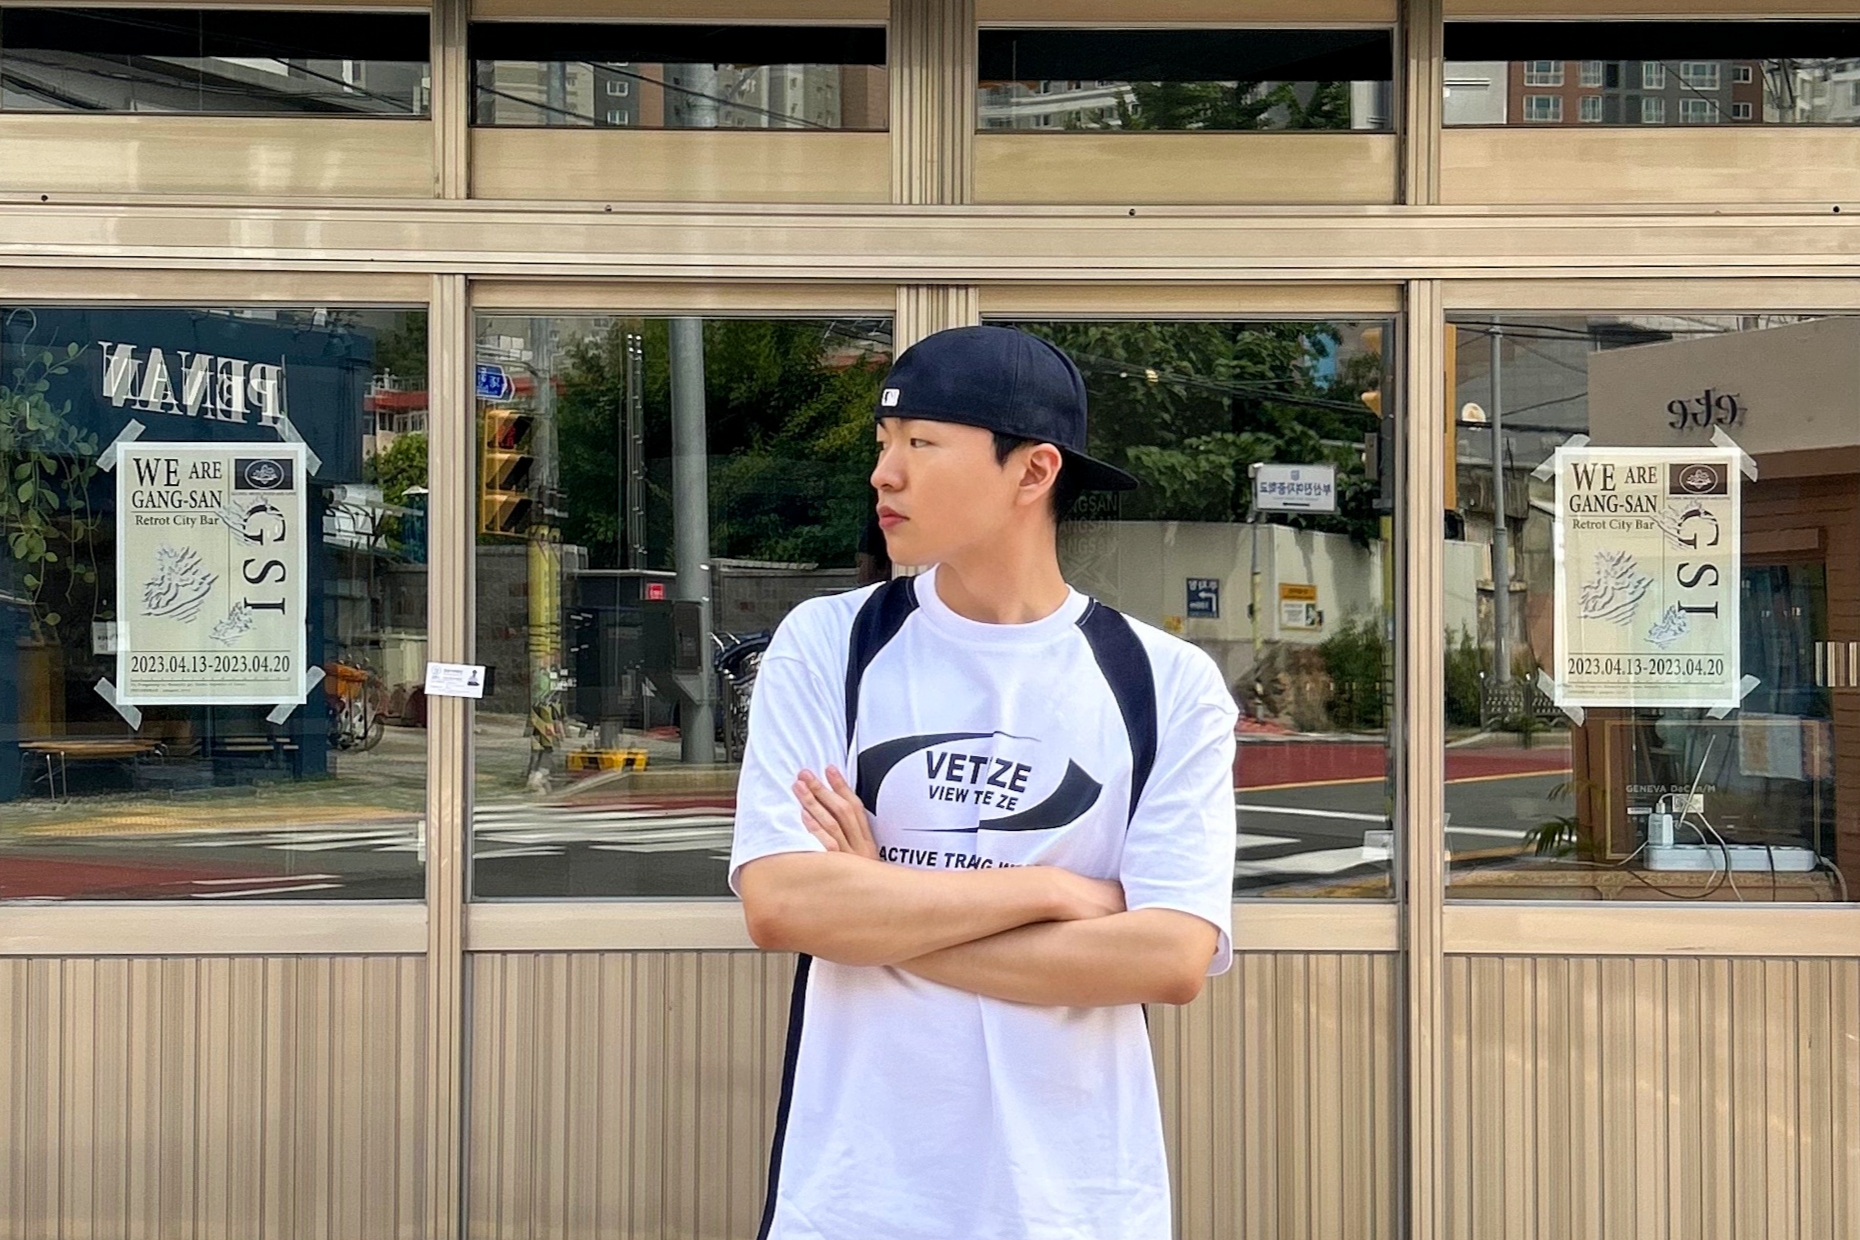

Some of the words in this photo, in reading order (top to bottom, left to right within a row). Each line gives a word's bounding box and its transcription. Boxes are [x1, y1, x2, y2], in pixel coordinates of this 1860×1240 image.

[133, 458, 181, 487] WE
[188, 462, 222, 479] ARE
[1571, 463, 1617, 491] WE
[1624, 467, 1658, 484] ARE
[132, 490, 222, 509] GANG-SAN
[1569, 494, 1658, 513] GANG-SAN
[136, 515, 170, 526] Retrot
[173, 514, 197, 528] City
[200, 515, 219, 526] Bar
[1573, 519, 1606, 530] Retrot
[1609, 518, 1633, 532] City
[1636, 519, 1655, 530] Bar
[131, 655, 291, 673] 2023.04.13-2023.04.20
[1568, 657, 1724, 676] 2023.04.13-2023.04.20
[926, 750, 1032, 793] VETZE
[928, 785, 969, 803] VIEW
[974, 788, 993, 805] TE
[995, 794, 1018, 811] ZE
[1625, 784, 1667, 793] GENEVA
[879, 845, 938, 867] ACTIVE
